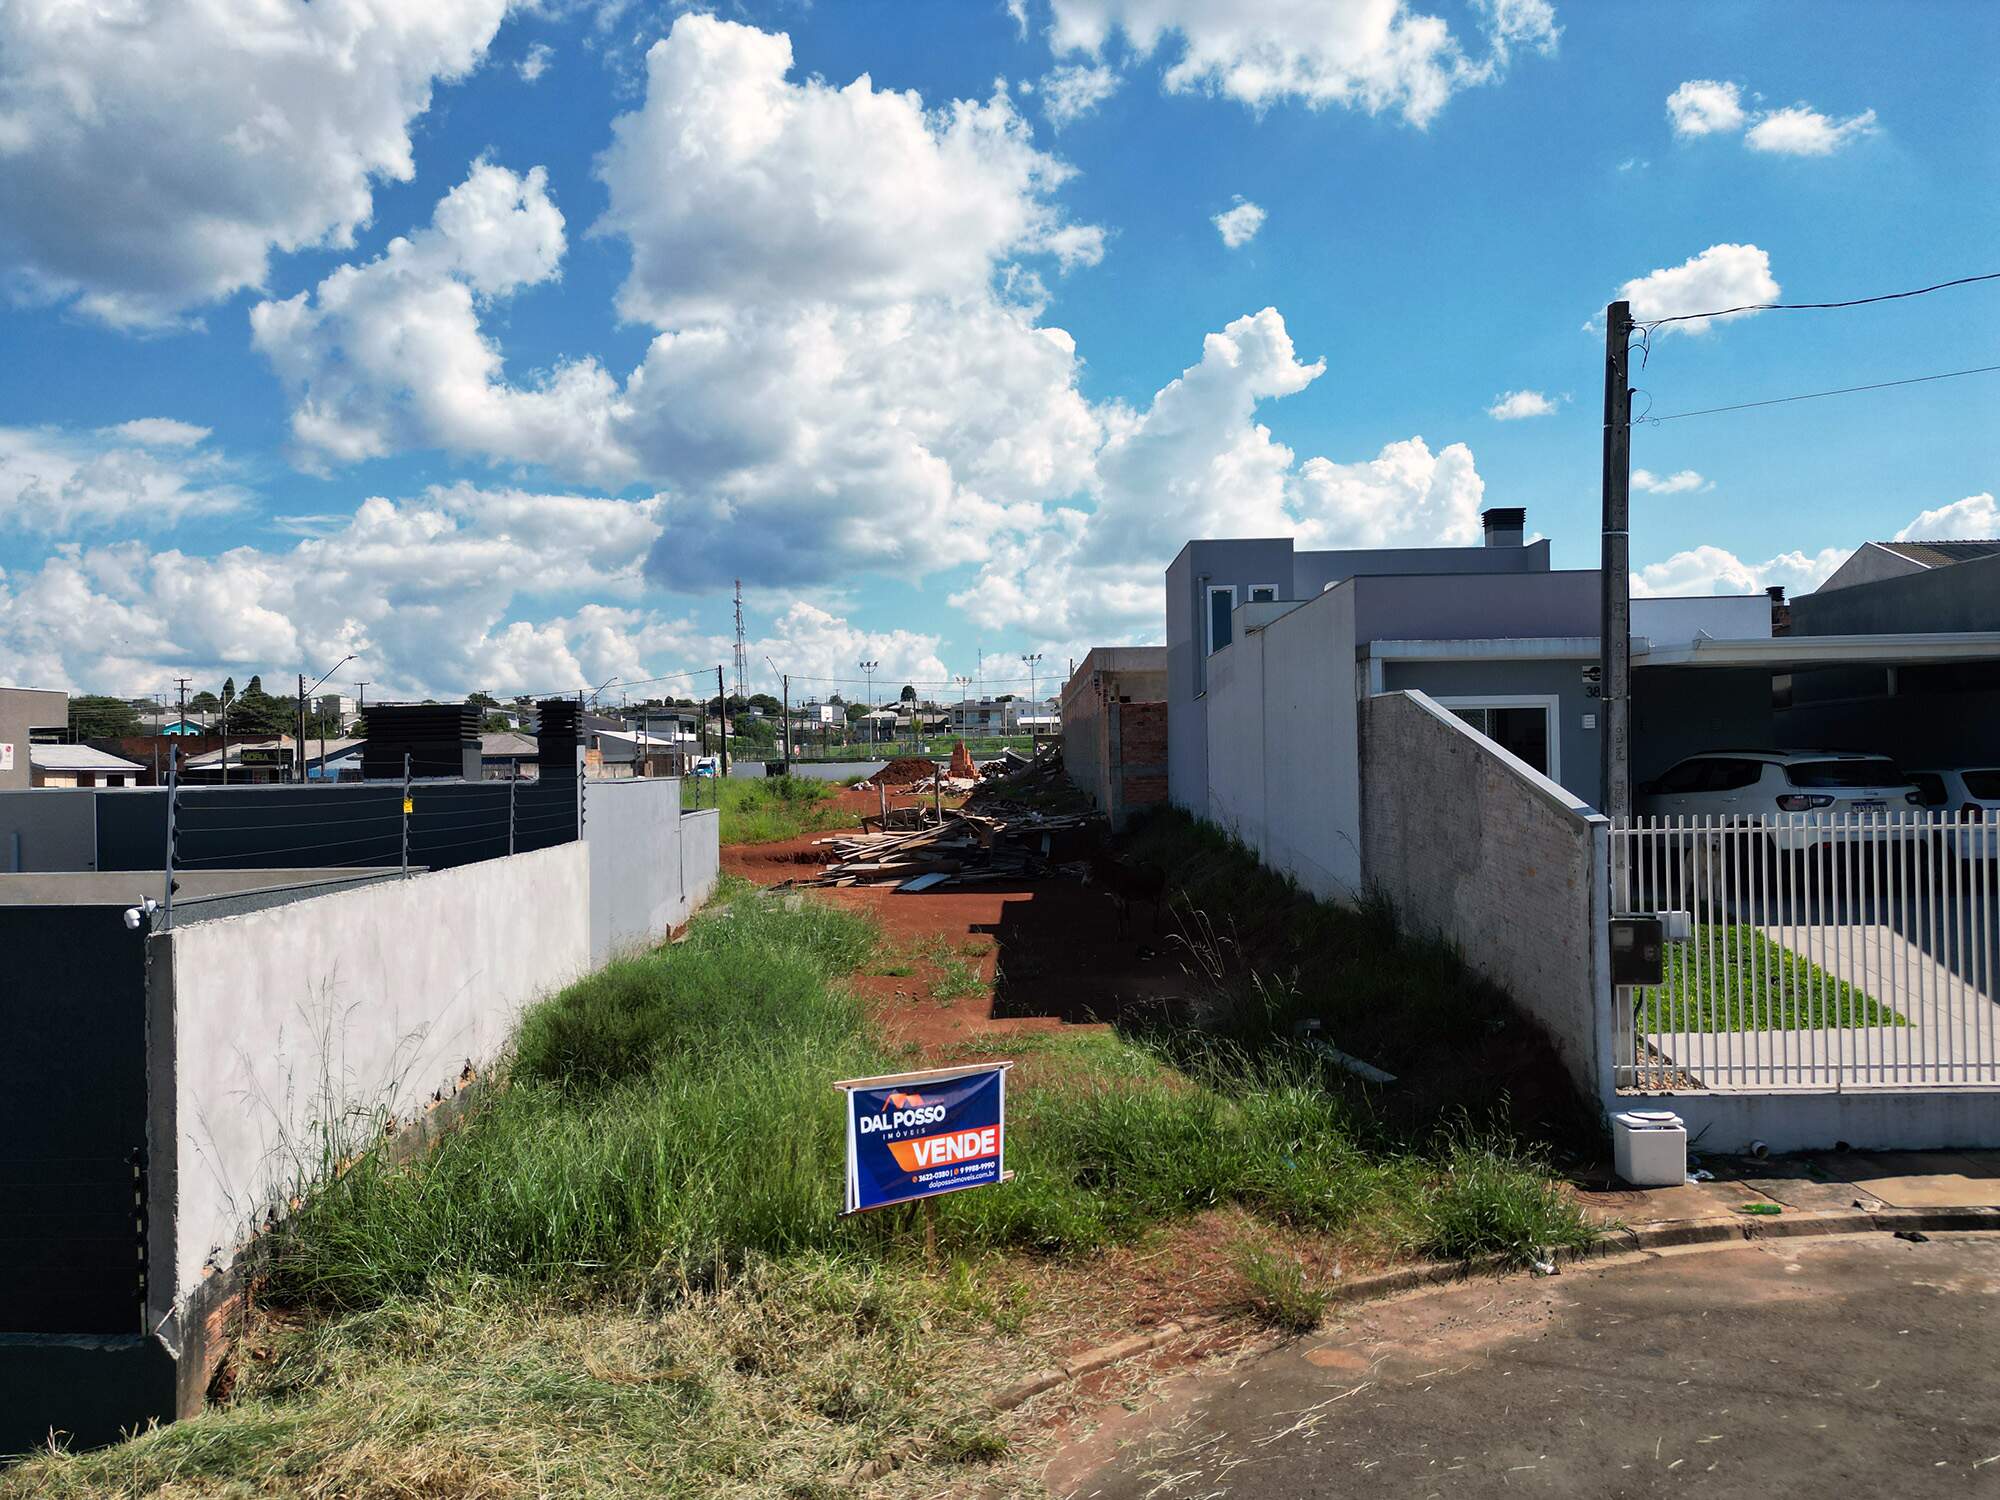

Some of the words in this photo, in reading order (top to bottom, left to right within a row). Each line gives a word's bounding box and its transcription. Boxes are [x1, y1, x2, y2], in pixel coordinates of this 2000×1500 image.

[860, 1113, 892, 1134] DAL
[893, 1105, 946, 1128] POSSO
[883, 1128, 926, 1140] IMÓVEIS
[912, 1129, 995, 1167] VENDE
